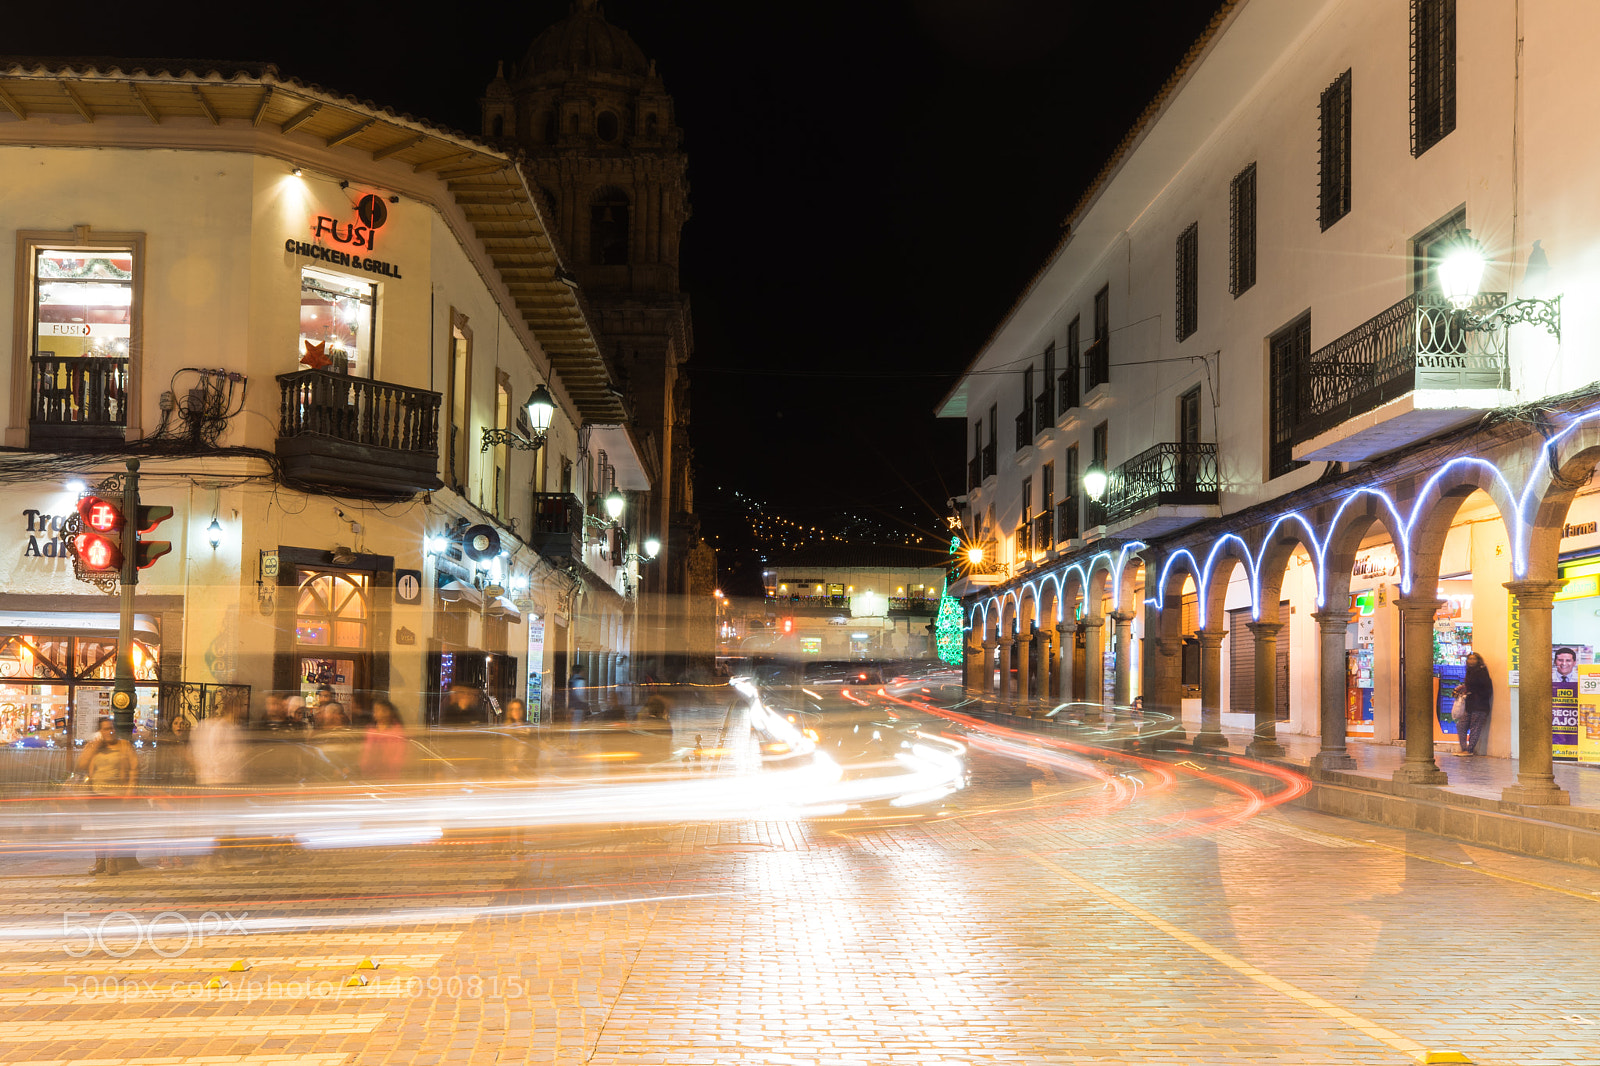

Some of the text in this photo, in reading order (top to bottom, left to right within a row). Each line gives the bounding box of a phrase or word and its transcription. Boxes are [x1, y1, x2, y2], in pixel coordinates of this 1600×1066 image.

[314, 215, 375, 251] FUSI
[285, 238, 350, 267] CHICKEN
[362, 258, 402, 279] GRILL
[52, 324, 79, 334] FUSI
[1583, 681, 1597, 689] 39
[1552, 717, 1579, 726] AJO
